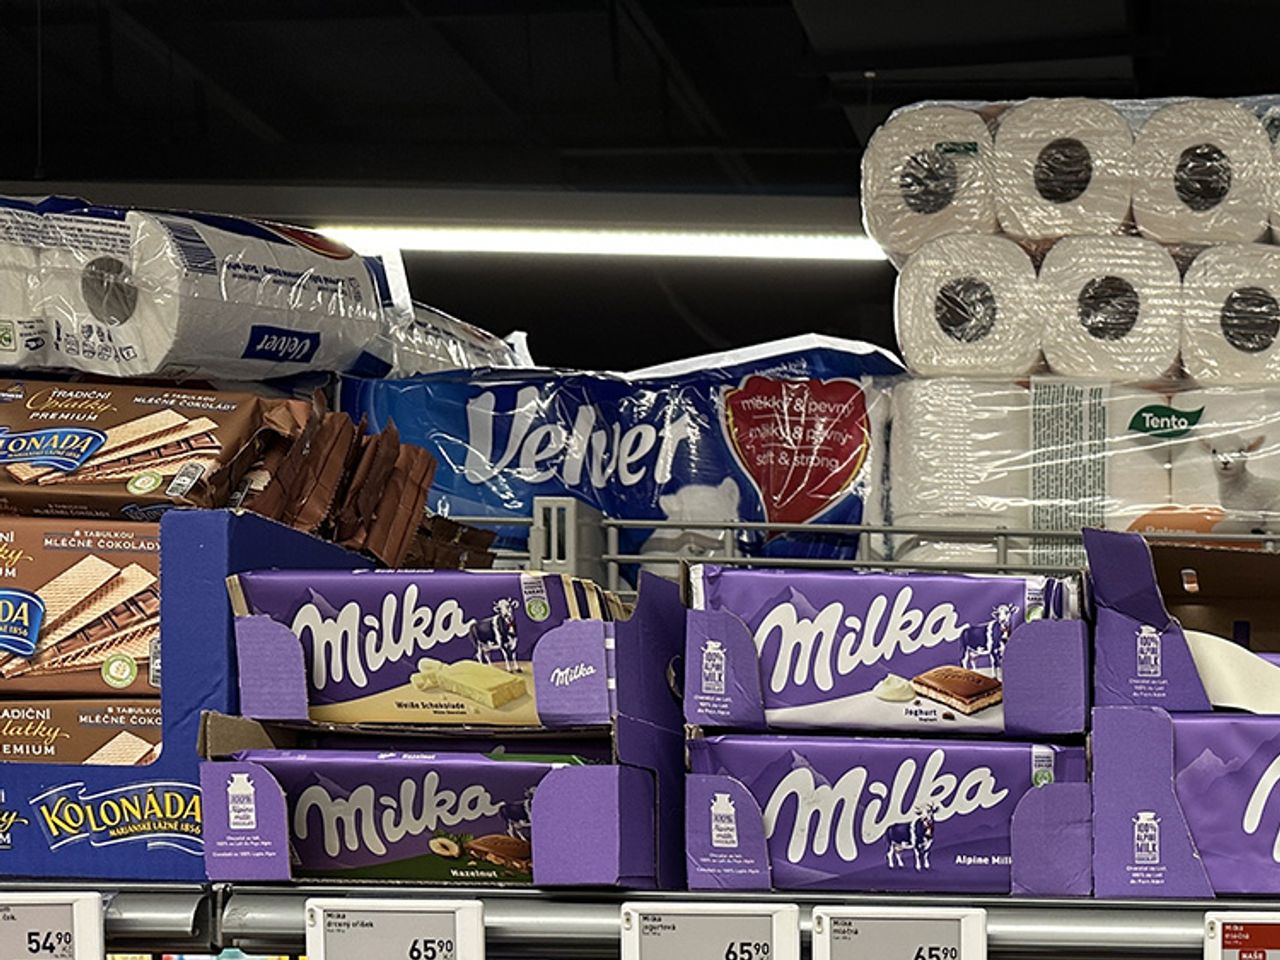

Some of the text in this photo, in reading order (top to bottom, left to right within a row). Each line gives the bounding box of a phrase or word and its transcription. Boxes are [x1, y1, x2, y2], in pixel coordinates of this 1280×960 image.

[794, 398, 804, 411] &
[808, 399, 854, 414] pevný
[29, 412, 99, 421] PREMIUM
[1142, 412, 1188, 430] Tento
[792, 427, 803, 440] &
[778, 453, 790, 466] &
[795, 453, 839, 471] strong
[290, 584, 476, 689] Milka
[754, 586, 970, 693] Milka
[550, 664, 596, 687] Milka
[904, 707, 937, 718] Joghurt
[41, 786, 201, 837] KOLONÁDA
[294, 770, 504, 857] Milka
[764, 748, 1009, 864] Milka
[955, 854, 1012, 866] Alpine Mil
[450, 868, 497, 877] Hazelnut
